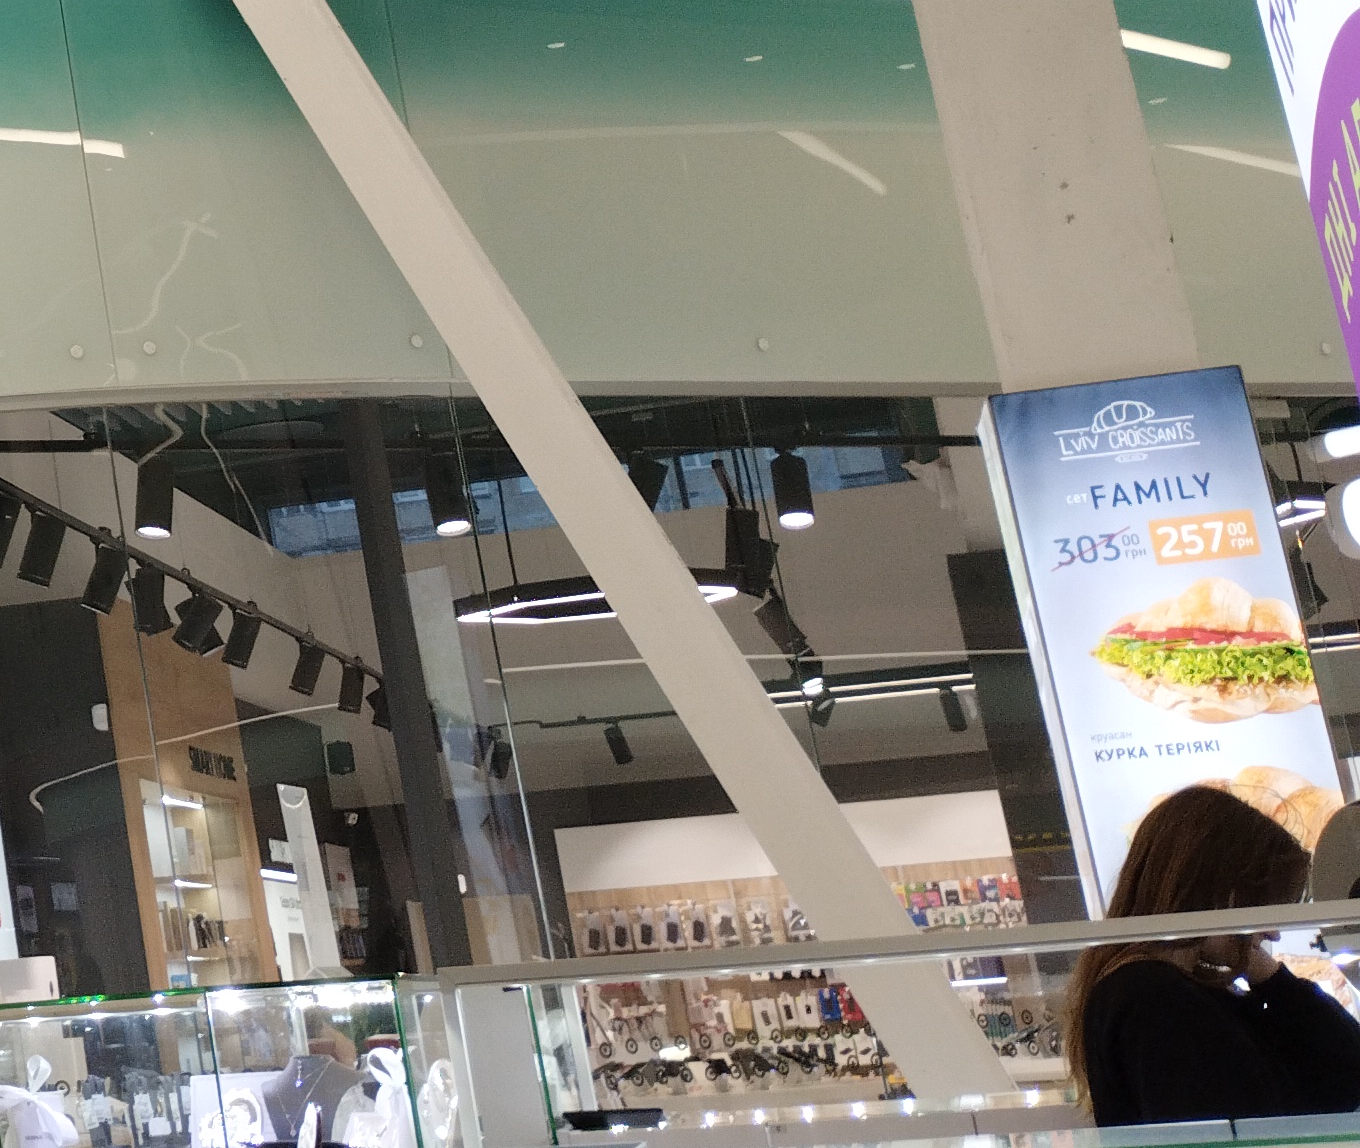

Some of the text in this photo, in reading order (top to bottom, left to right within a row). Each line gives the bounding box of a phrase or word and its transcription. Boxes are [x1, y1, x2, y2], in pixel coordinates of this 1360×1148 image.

[1090, 472, 1210, 510] FAMILY
[1053, 533, 1140, 567] 303 00
[1124, 547, 1147, 560] грн
[1156, 521, 1248, 558] 257 00
[1231, 536, 1254, 551] грн
[1094, 739, 1221, 763] КУРКА ТЕРІЯКІ
